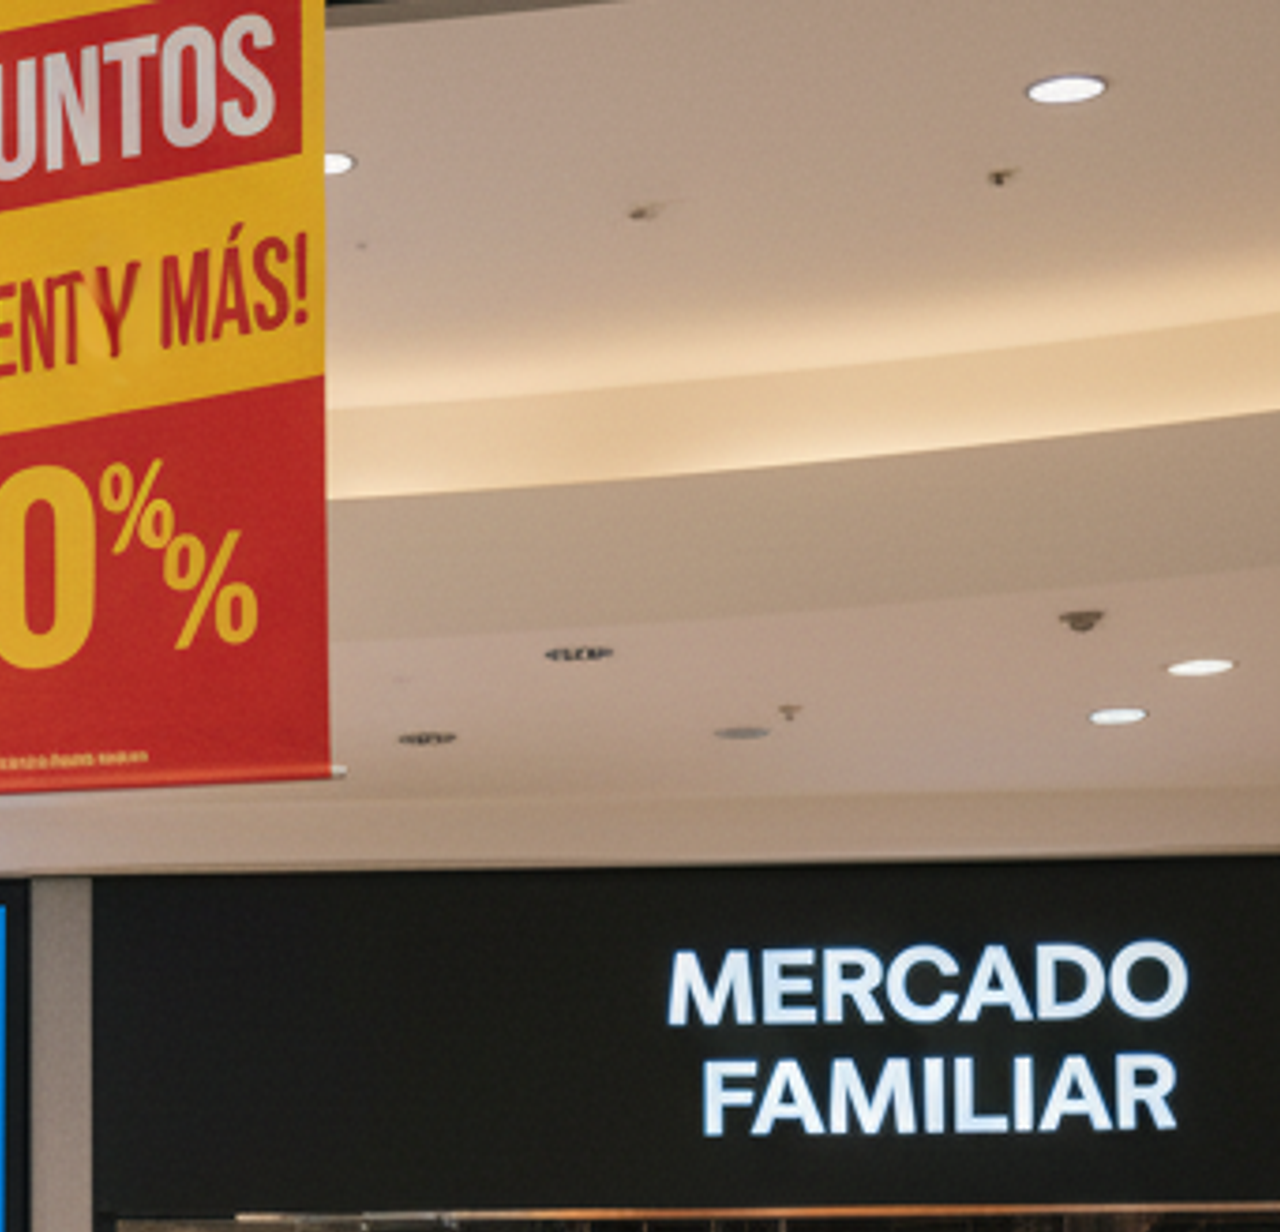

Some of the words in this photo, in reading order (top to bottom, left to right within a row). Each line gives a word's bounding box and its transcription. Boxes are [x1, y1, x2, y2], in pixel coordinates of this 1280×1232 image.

[160, 222, 308, 350] MÁS!
[667, 939, 1188, 1026] MERCADO
[702, 1052, 1177, 1136] FAMILIAR
